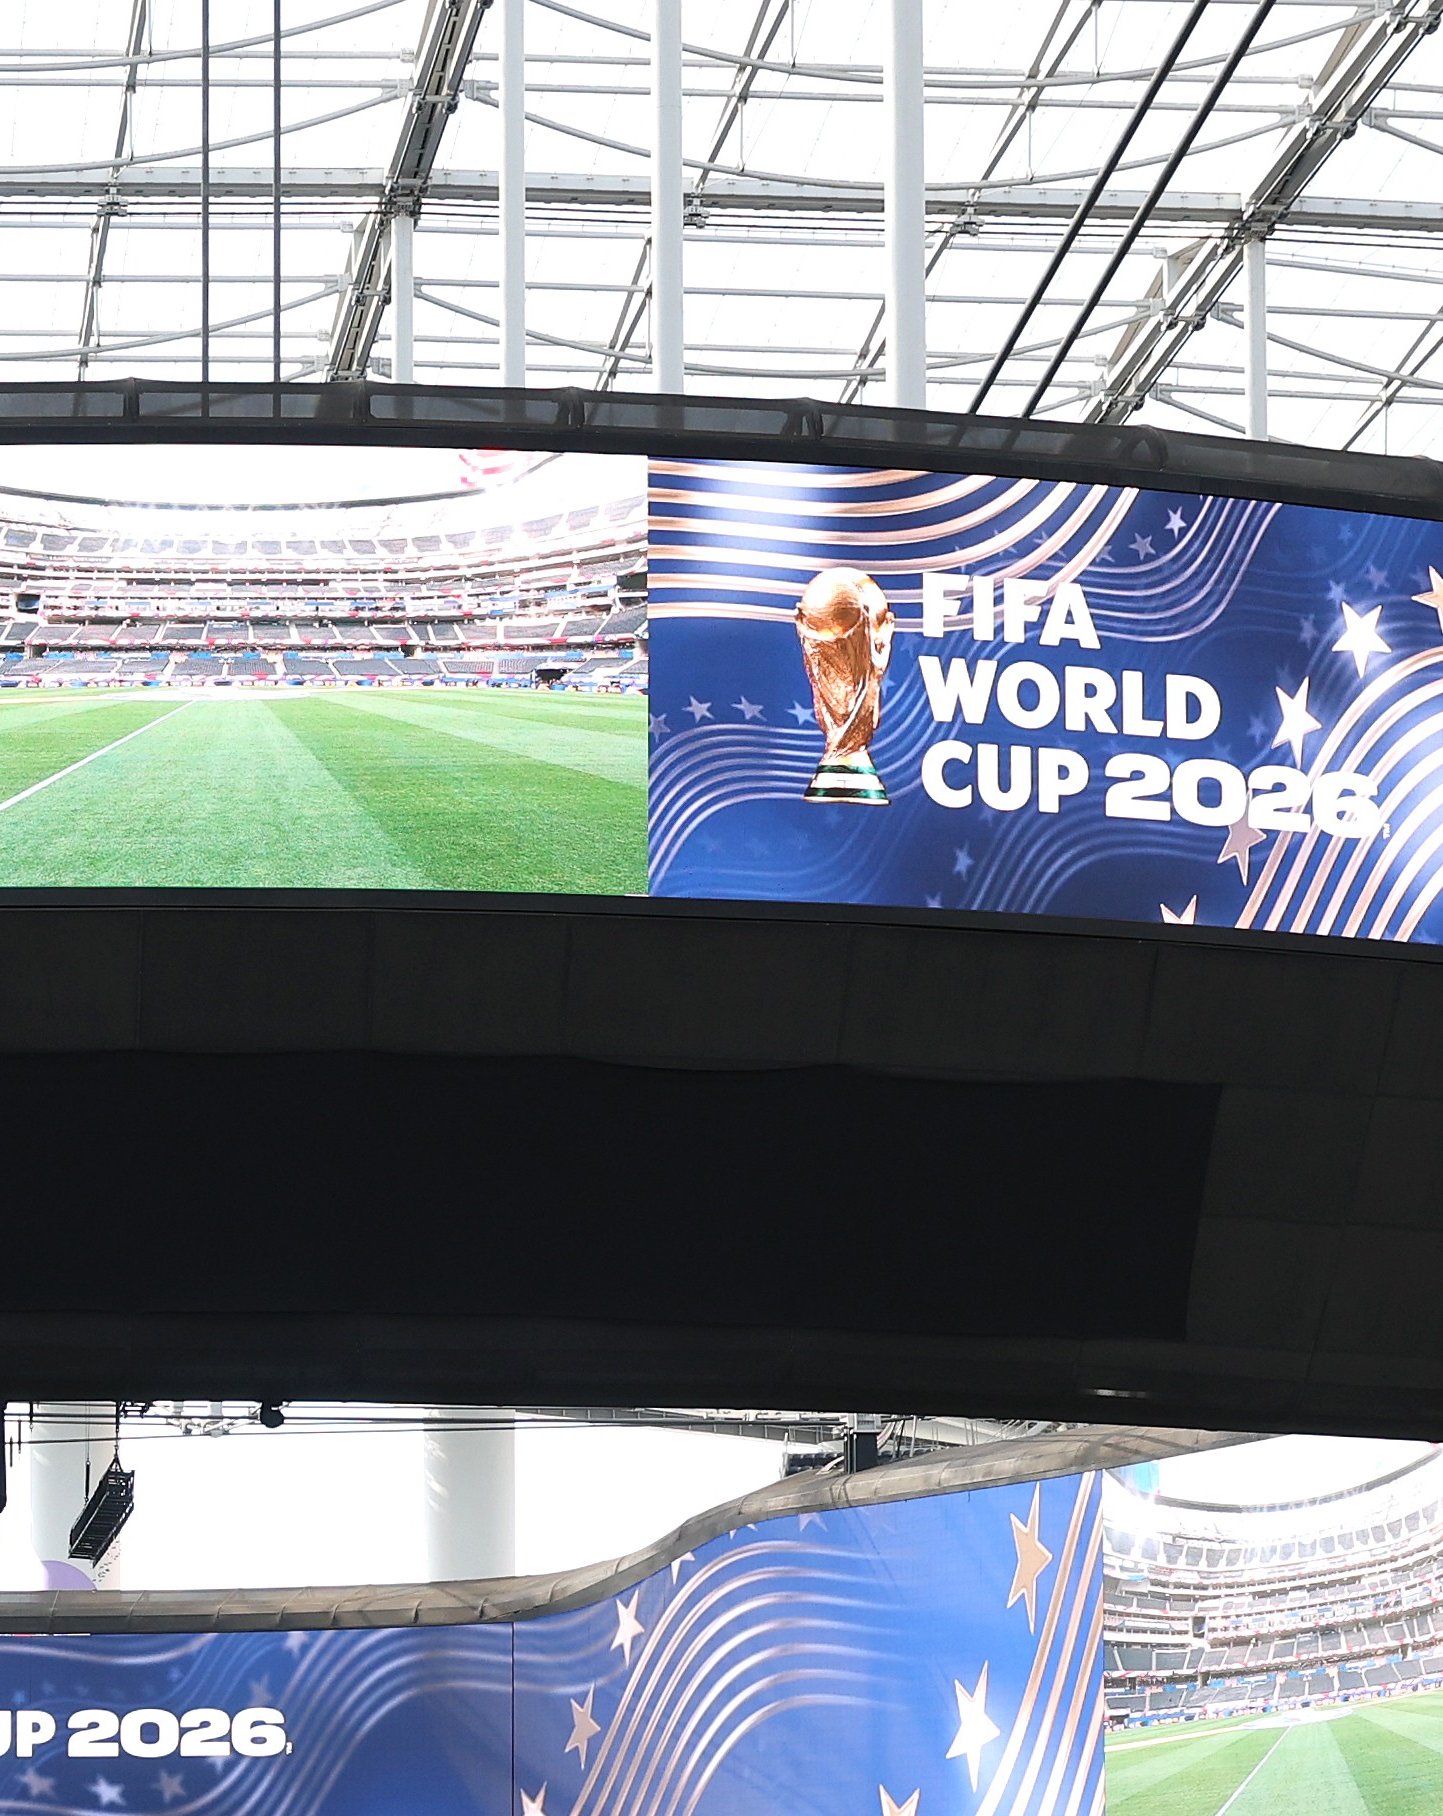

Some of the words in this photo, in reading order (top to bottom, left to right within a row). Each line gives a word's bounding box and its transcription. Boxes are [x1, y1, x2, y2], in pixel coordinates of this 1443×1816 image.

[922, 571, 1103, 650] FIFA
[918, 654, 1222, 740] WORLD
[921, 740, 1090, 814] CUP
[1103, 752, 1383, 838] 2026
[67, 1707, 287, 1763] 2026
